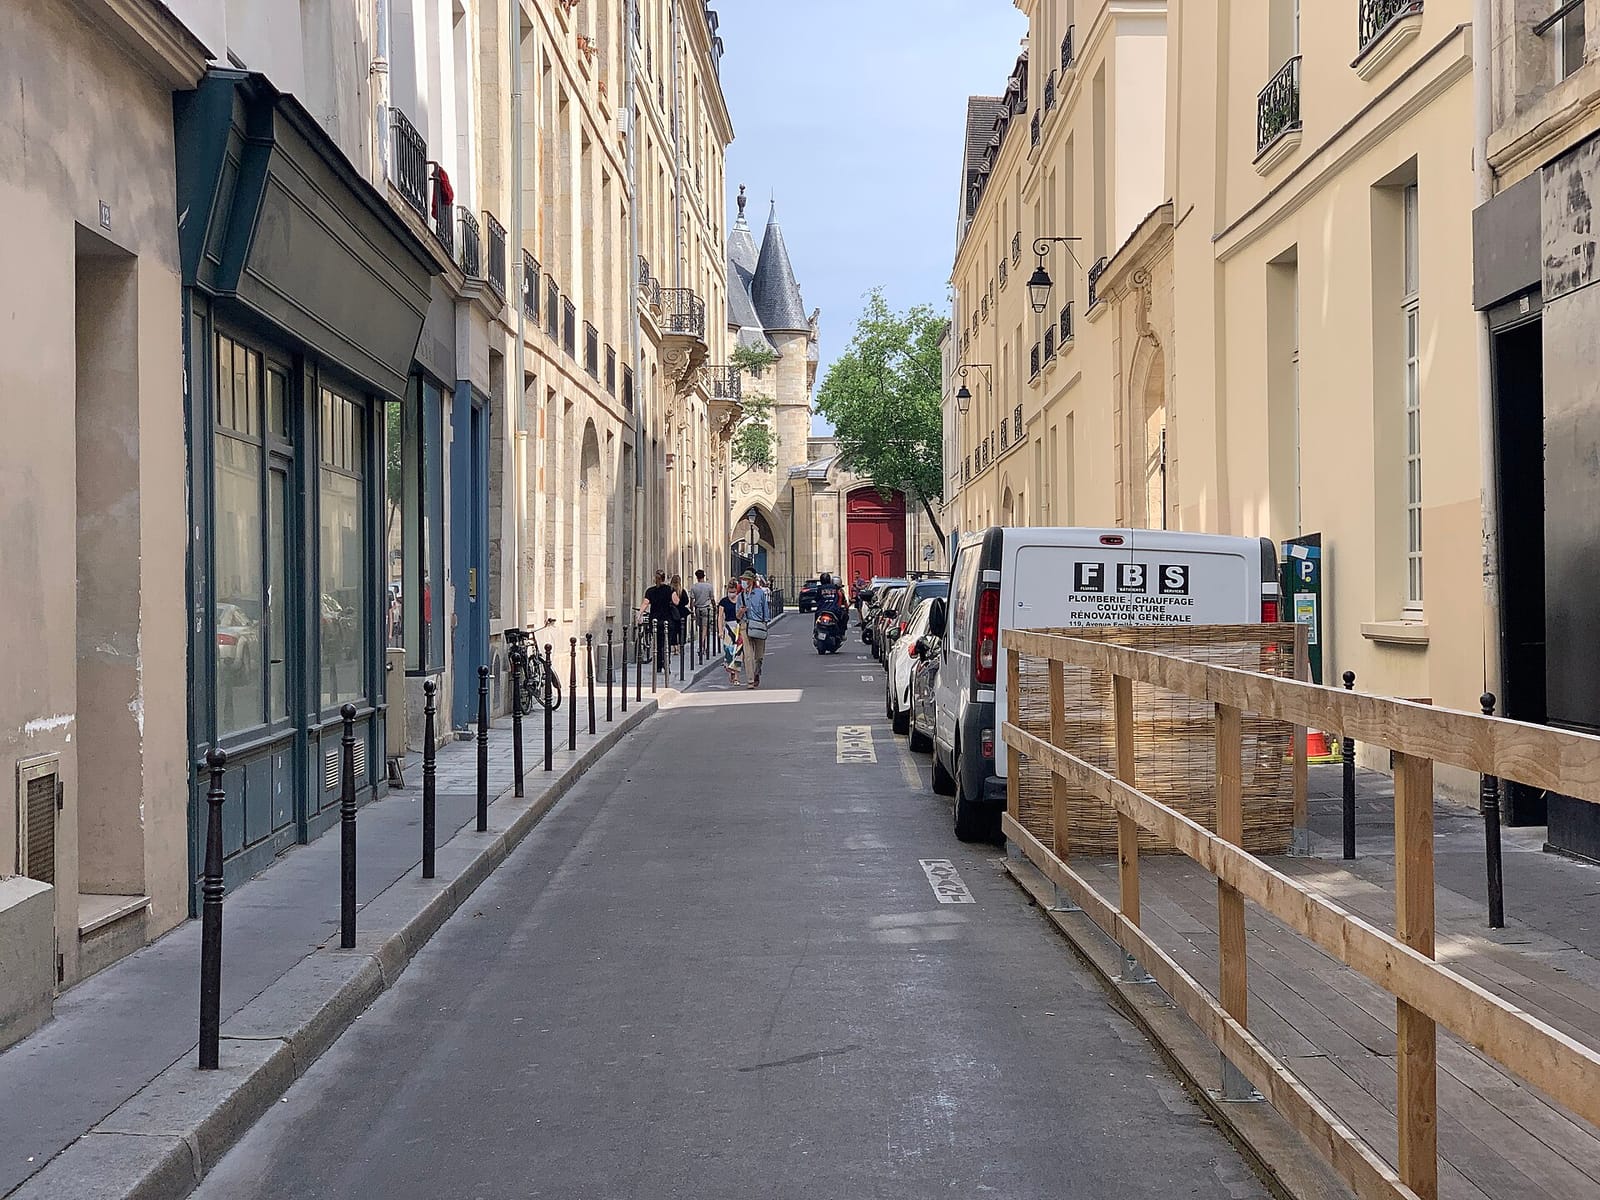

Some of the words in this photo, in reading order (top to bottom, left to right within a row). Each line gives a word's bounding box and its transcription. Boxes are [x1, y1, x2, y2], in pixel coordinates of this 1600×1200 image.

[1081, 563, 1099, 585] F
[1123, 564, 1144, 587] B
[1164, 566, 1185, 588] S
[1301, 562, 1314, 580] P
[1068, 594, 1126, 603] PLOMBERIE
[1135, 597, 1194, 606] CHAUFFAGE
[1097, 604, 1166, 613] COUVERTURE
